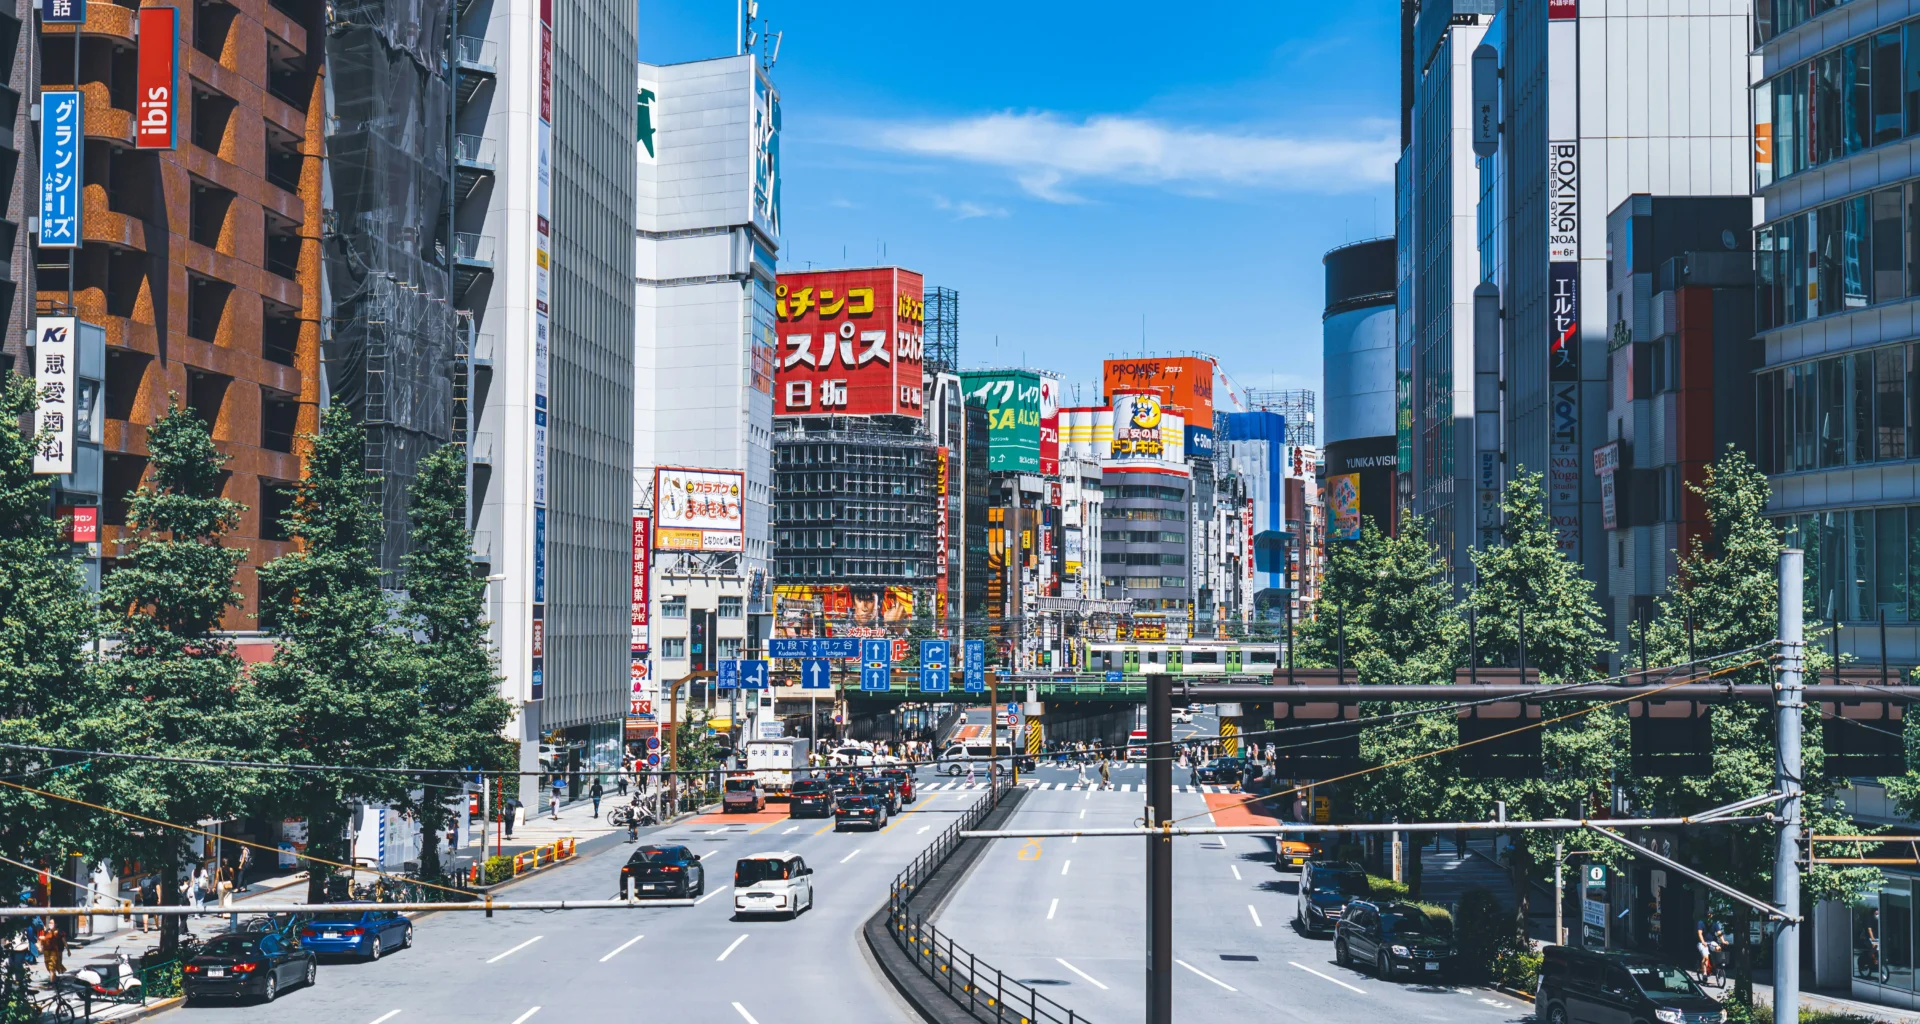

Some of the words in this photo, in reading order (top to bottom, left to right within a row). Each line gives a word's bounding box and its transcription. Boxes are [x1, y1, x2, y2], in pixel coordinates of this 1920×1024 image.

[142, 87, 168, 134] ibis
[53, 99, 76, 238] グランシーズ
[1550, 145, 1558, 198] FITNESS
[1558, 145, 1576, 233] BOXING
[1550, 201, 1558, 227] GYM
[1550, 235, 1577, 244] NOA
[1563, 248, 1574, 256] 6F
[898, 290, 923, 322] パチンコ
[1553, 279, 1576, 368] エルセーヌ
[898, 325, 923, 360] エスパス
[1112, 363, 1160, 375] PROMISE
[785, 379, 848, 407] 日拓
[901, 385, 921, 405] 日拓
[1018, 384, 1039, 404] レイク
[43, 352, 66, 462] 恵愛歯科
[1018, 408, 1039, 427] ALSA
[1040, 427, 1058, 444] アコム
[1200, 434, 1212, 449] 50m
[1346, 457, 1375, 469] YUNIKA
[1552, 457, 1578, 468] NOA
[937, 454, 946, 494] パチンコ
[1552, 470, 1578, 482] Yoga
[695, 482, 730, 494] カラオケ
[685, 499, 739, 520] まねきねこ
[1552, 516, 1579, 527] NOA
[673, 538, 699, 546] ワンカラ
[633, 520, 645, 602] 東京調理製菓
[632, 602, 646, 613] 専門
[632, 612, 646, 623] 学校
[847, 627, 885, 637] メガホール
[776, 640, 809, 650] 九段下
[727, 661, 736, 687] 小滝橋
[973, 643, 982, 690] 新宿駅東口
